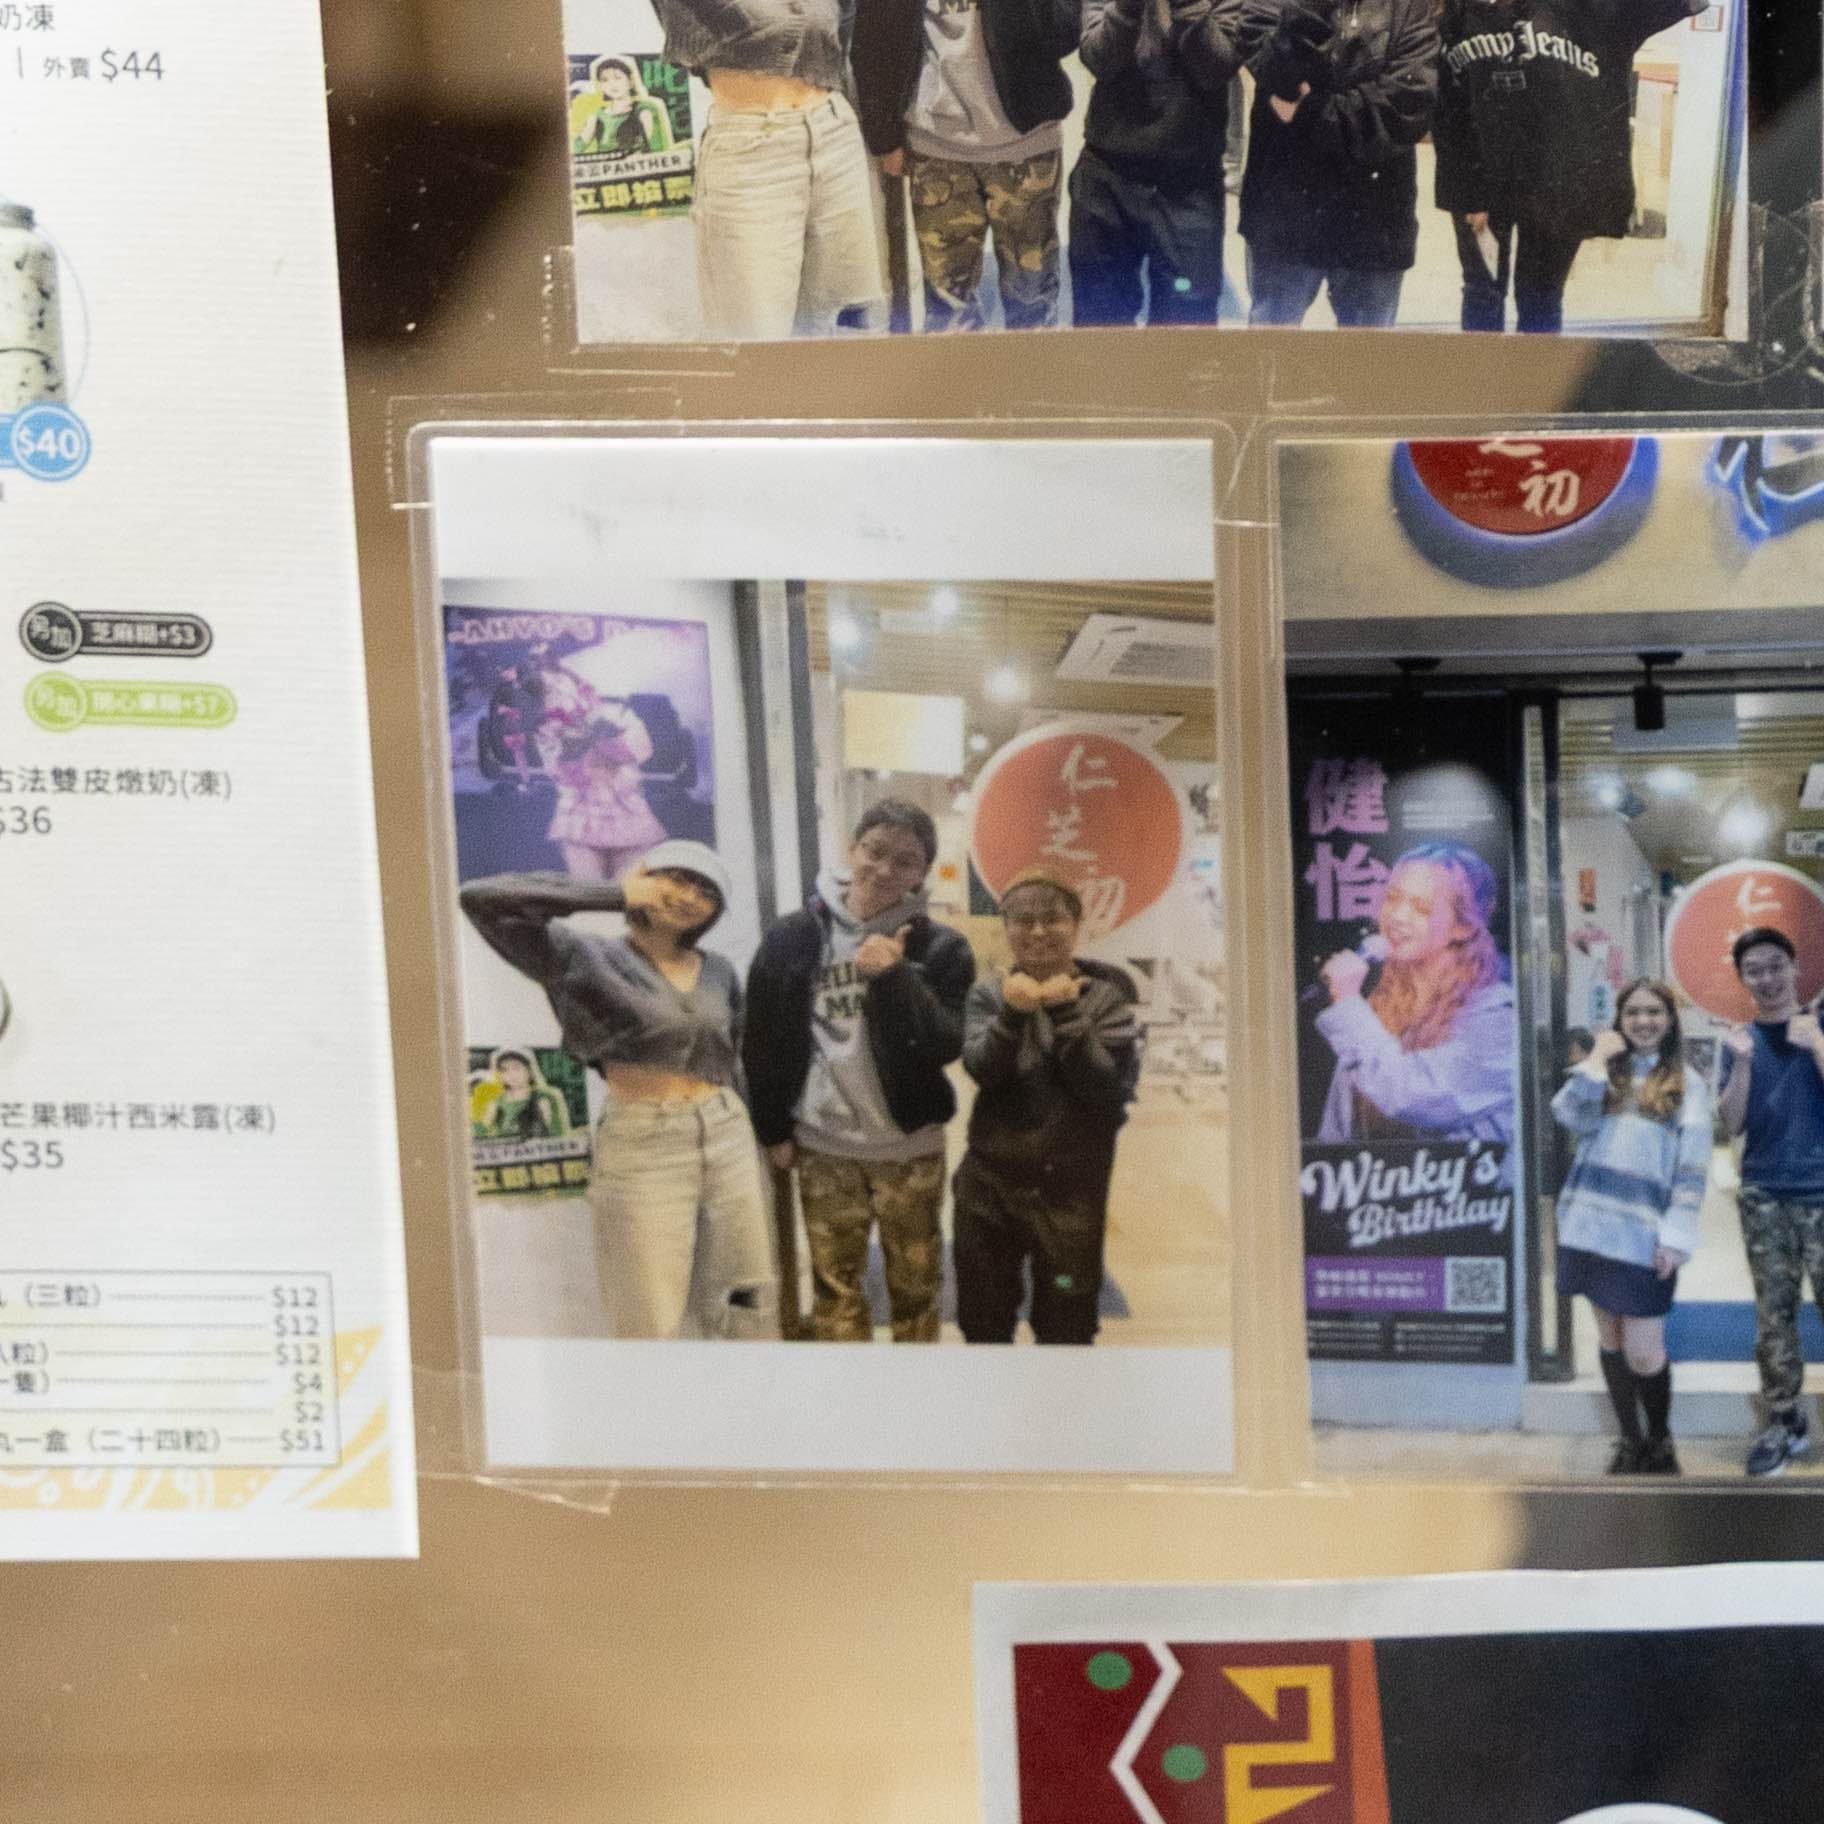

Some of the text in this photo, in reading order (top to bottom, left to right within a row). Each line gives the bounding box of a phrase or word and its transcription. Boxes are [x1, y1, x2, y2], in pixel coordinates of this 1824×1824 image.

[1513, 20, 1599, 78] Jeans
[43, 46, 164, 82] 外賣 $44
[602, 154, 684, 175] PANTHER
[18, 426, 81, 461] $40
[2, 1139, 65, 1172] $35
[1300, 1138, 1501, 1212] Winky's
[1348, 1192, 1510, 1250] Birthday
[272, 1285, 318, 1309] $12
[274, 1314, 320, 1338] $12
[276, 1342, 322, 1366] $12
[292, 1373, 322, 1395] $4
[295, 1402, 325, 1425] $2
[280, 1428, 325, 1453] $51
